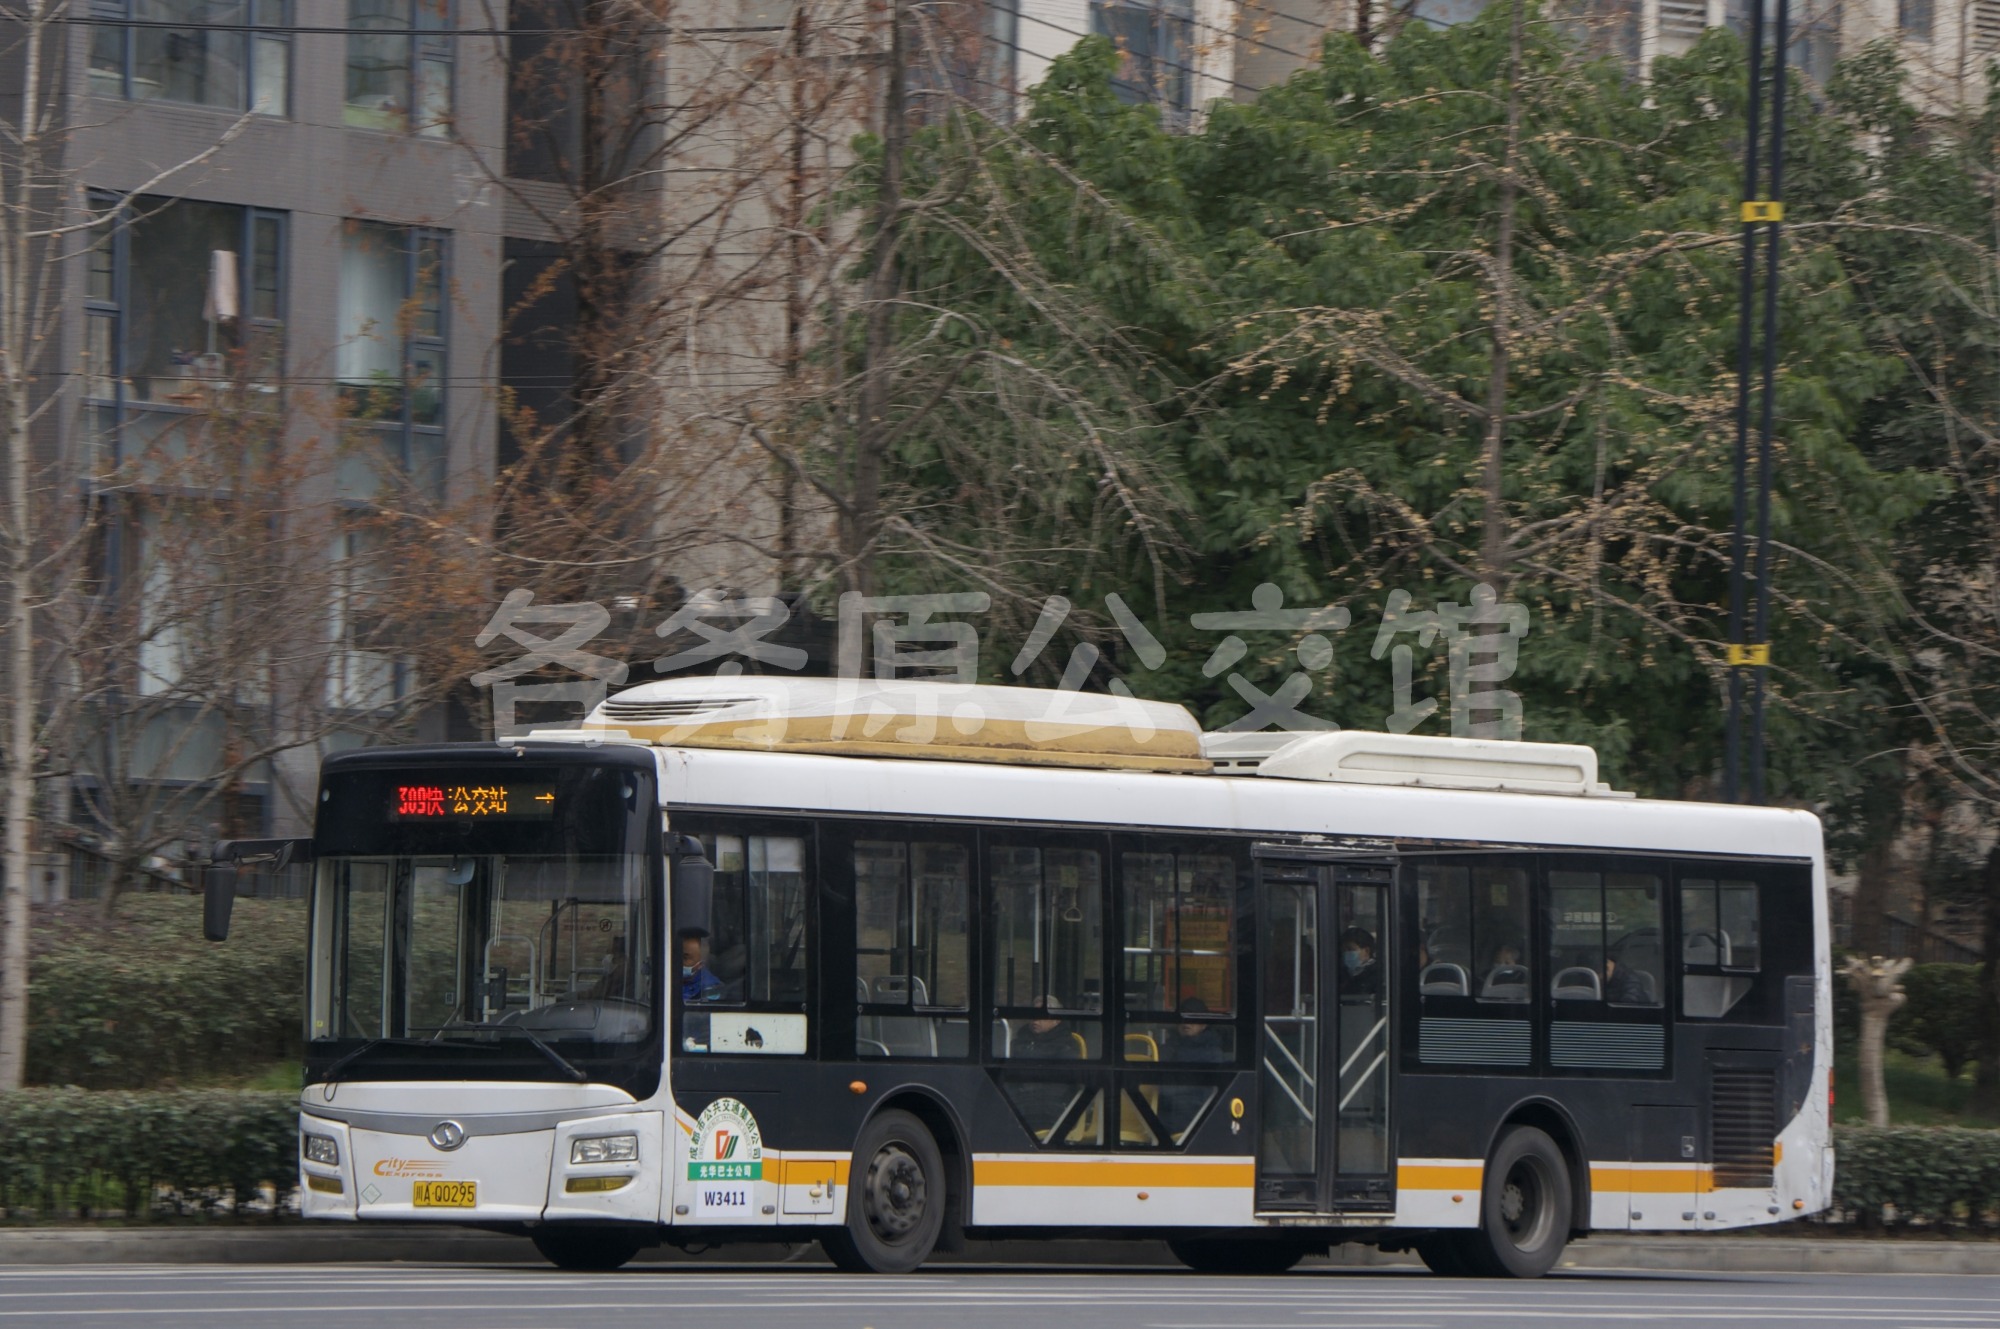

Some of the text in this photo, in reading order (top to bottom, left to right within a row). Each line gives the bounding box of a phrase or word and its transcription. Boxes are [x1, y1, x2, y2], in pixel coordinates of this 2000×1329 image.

[689, 1098, 761, 1160] 成都市公共交通集团公司
[373, 1157, 407, 1176] City
[384, 1170, 443, 1178] Express
[700, 1165, 751, 1178] 光华巴士公司
[704, 1191, 746, 1206] W3411
